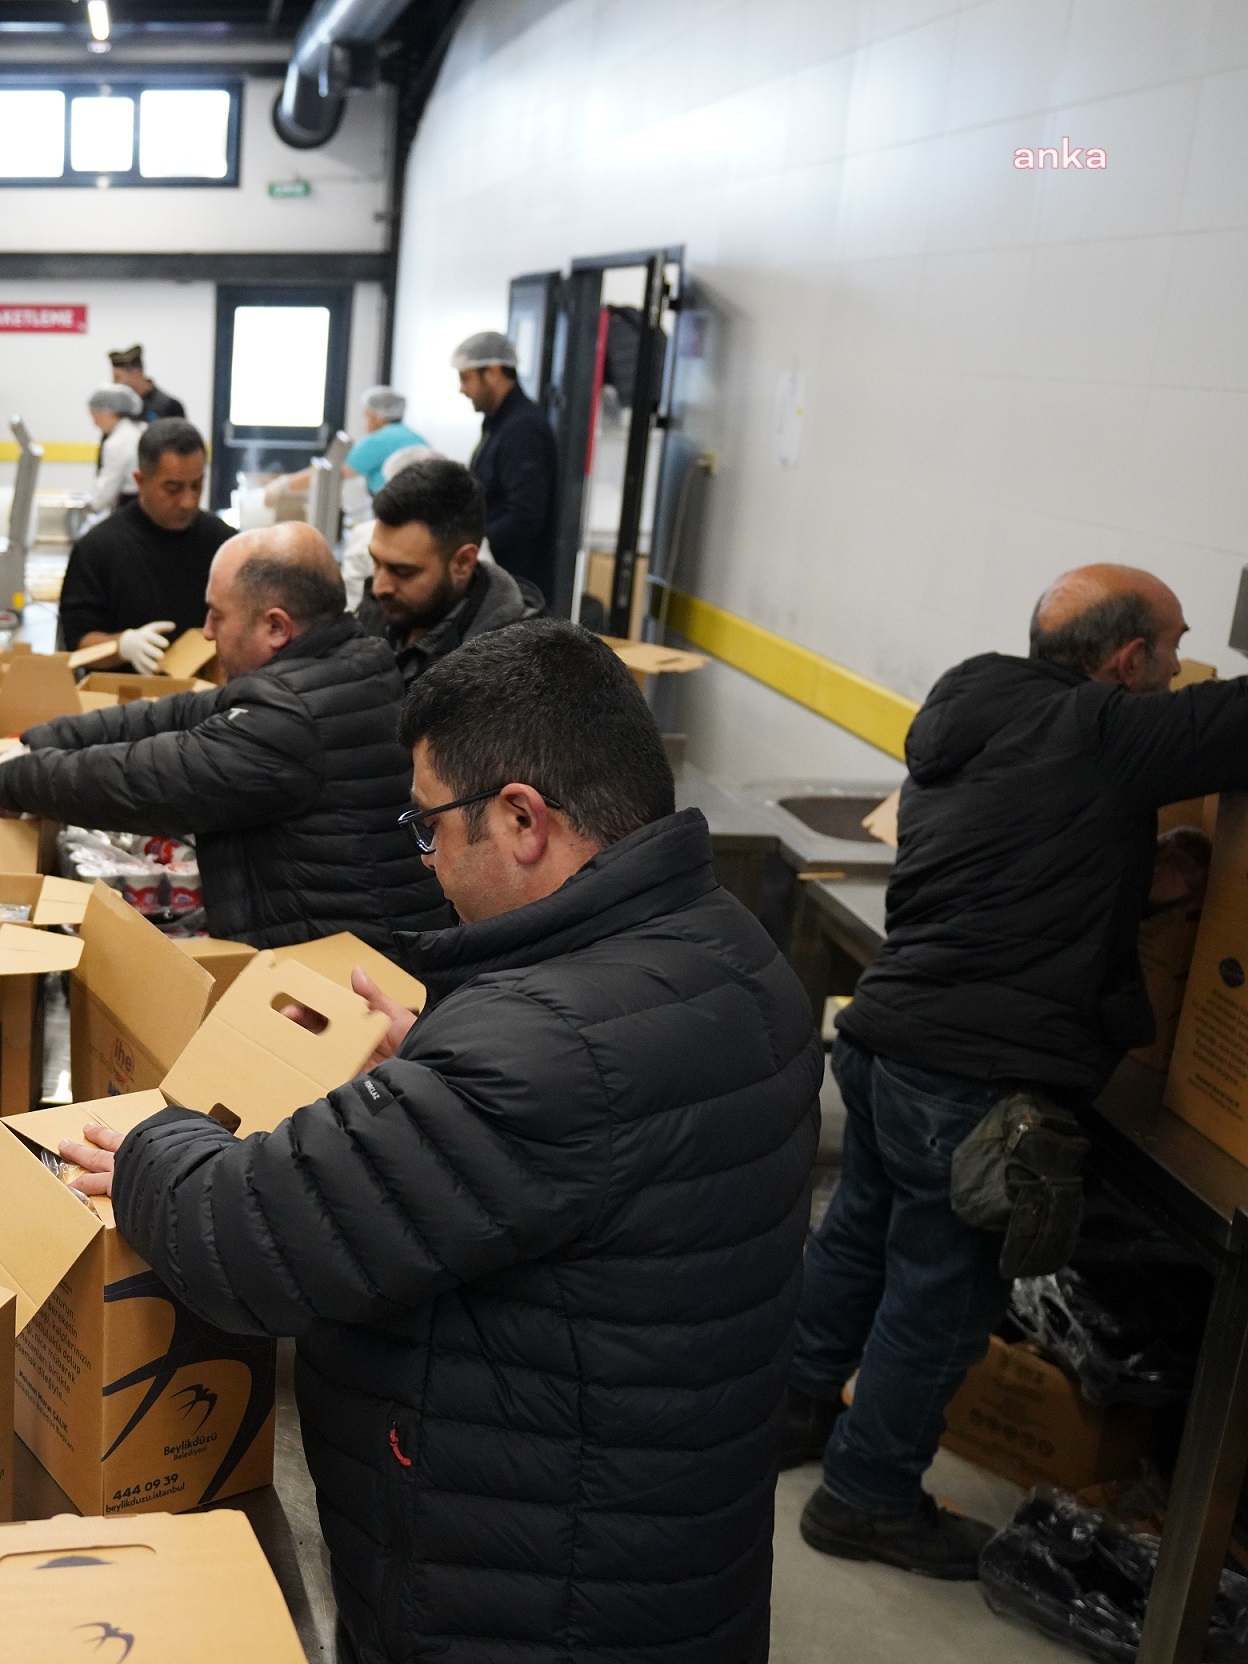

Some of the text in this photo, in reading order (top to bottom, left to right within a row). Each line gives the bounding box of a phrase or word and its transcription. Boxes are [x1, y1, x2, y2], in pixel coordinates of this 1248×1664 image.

[163, 1432, 217, 1456] Beylikdüzü
[105, 1482, 185, 1513] beylikduzu.istanbul
[113, 1473, 179, 1500] 444 09 39
